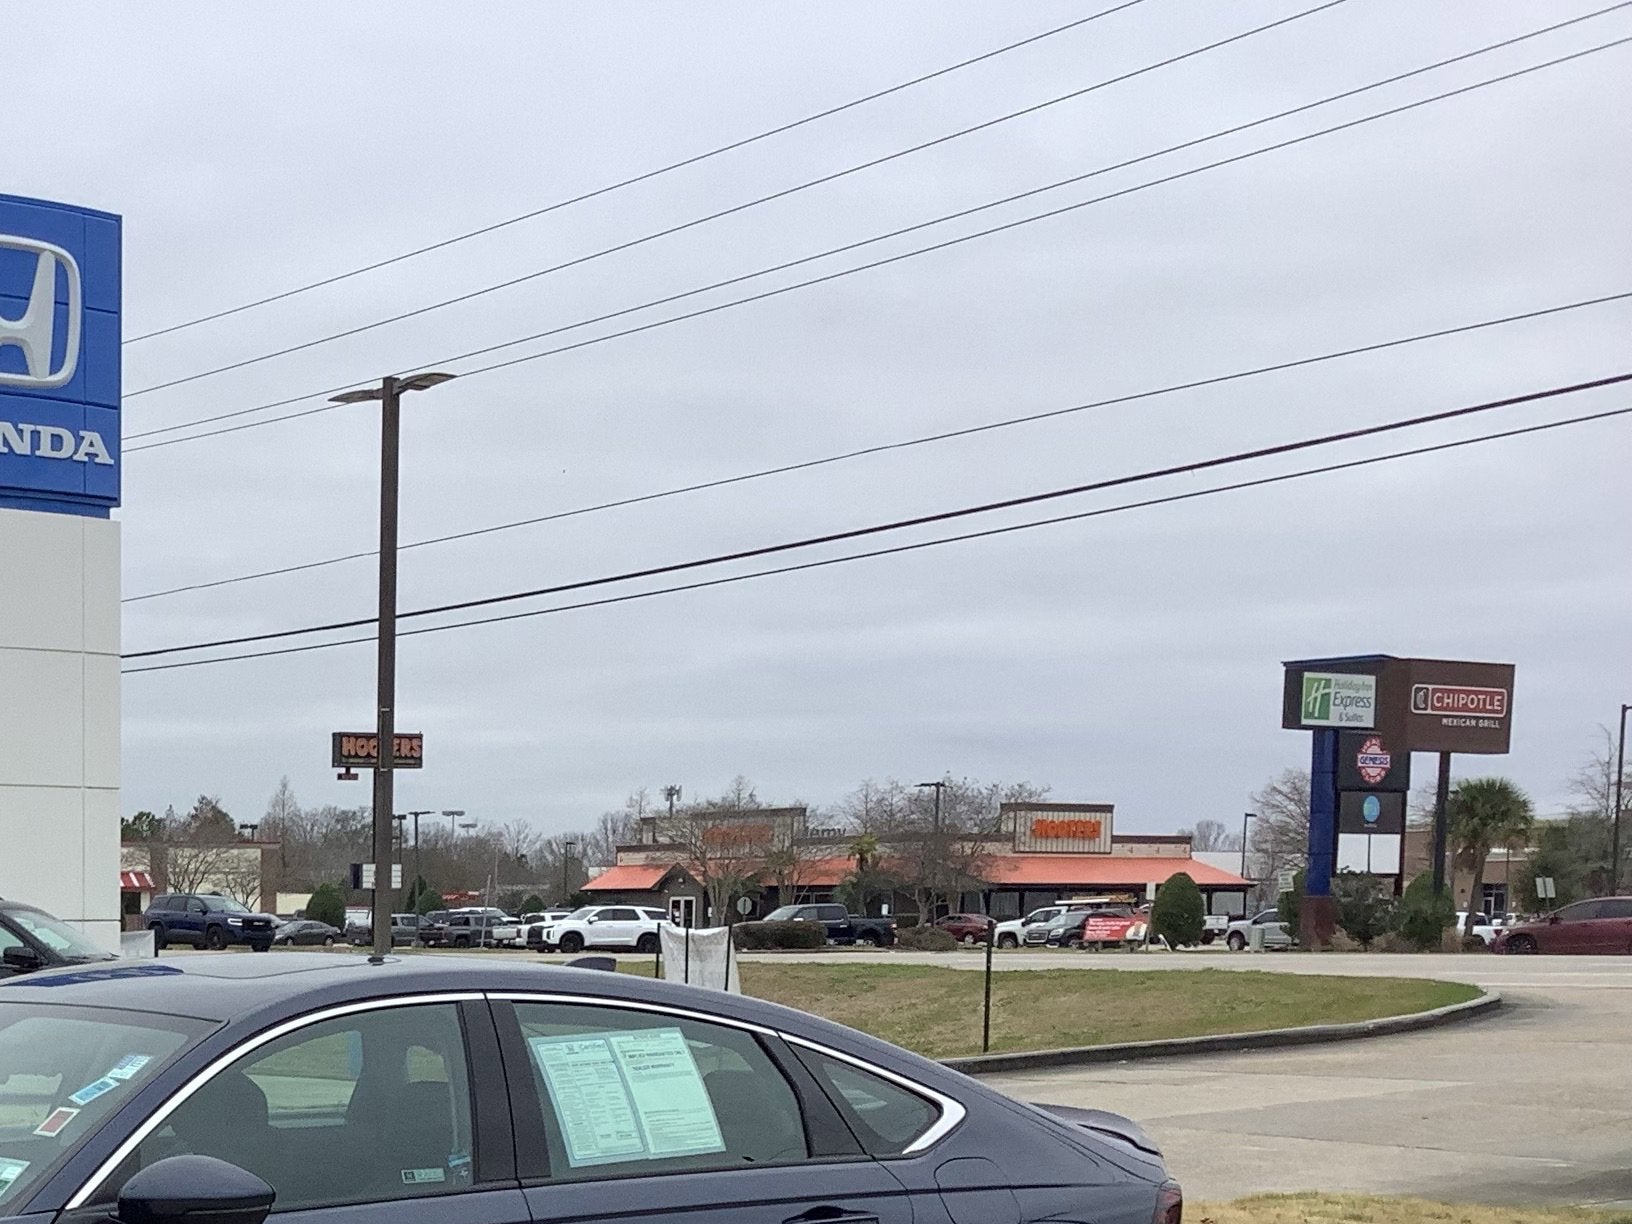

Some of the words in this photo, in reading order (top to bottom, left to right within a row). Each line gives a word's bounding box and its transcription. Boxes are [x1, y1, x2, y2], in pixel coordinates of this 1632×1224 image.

[1333, 691, 1372, 711] Express
[1433, 692, 1502, 711] CHIPOTLE
[1441, 718, 1476, 726] MEXICAN
[1478, 719, 1500, 728] GRILL
[341, 736, 422, 757] HOOERS
